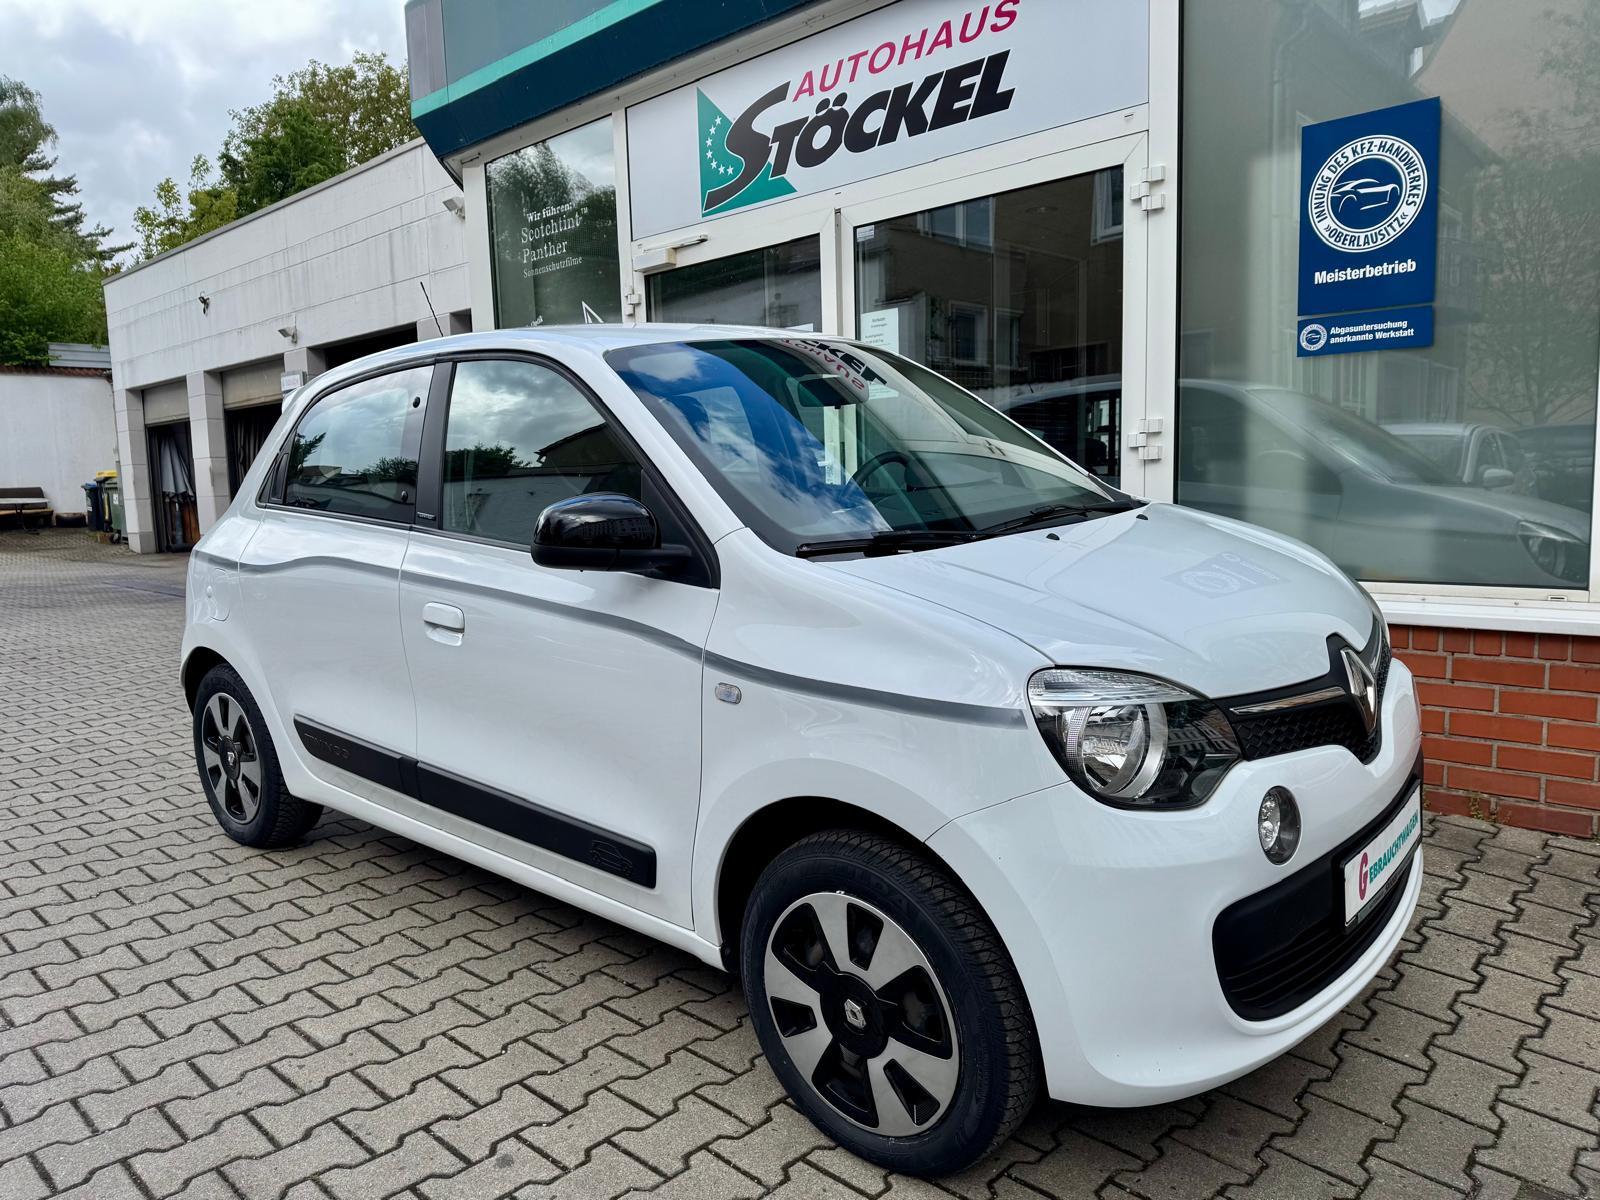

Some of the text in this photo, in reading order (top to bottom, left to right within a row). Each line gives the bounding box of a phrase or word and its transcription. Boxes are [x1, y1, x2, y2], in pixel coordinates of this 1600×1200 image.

[792, 0, 1020, 102] AUTOHAUS
[703, 49, 1016, 212] STÖCKEL
[1313, 140, 1422, 224] INNUNG DES KFZ-HANDWERKES
[527, 211, 541, 223] Wir
[523, 241, 568, 264] Panther
[523, 256, 583, 278] Sonnenschutzfilme
[1314, 259, 1417, 285] Meisterbetrieb
[1330, 320, 1408, 335] Abgasuntersuchung
[1330, 333, 1374, 344] anerkannte
[1375, 328, 1415, 340] Werkstatt
[1359, 809, 1419, 901] GEBRAUCHTWAGEN
